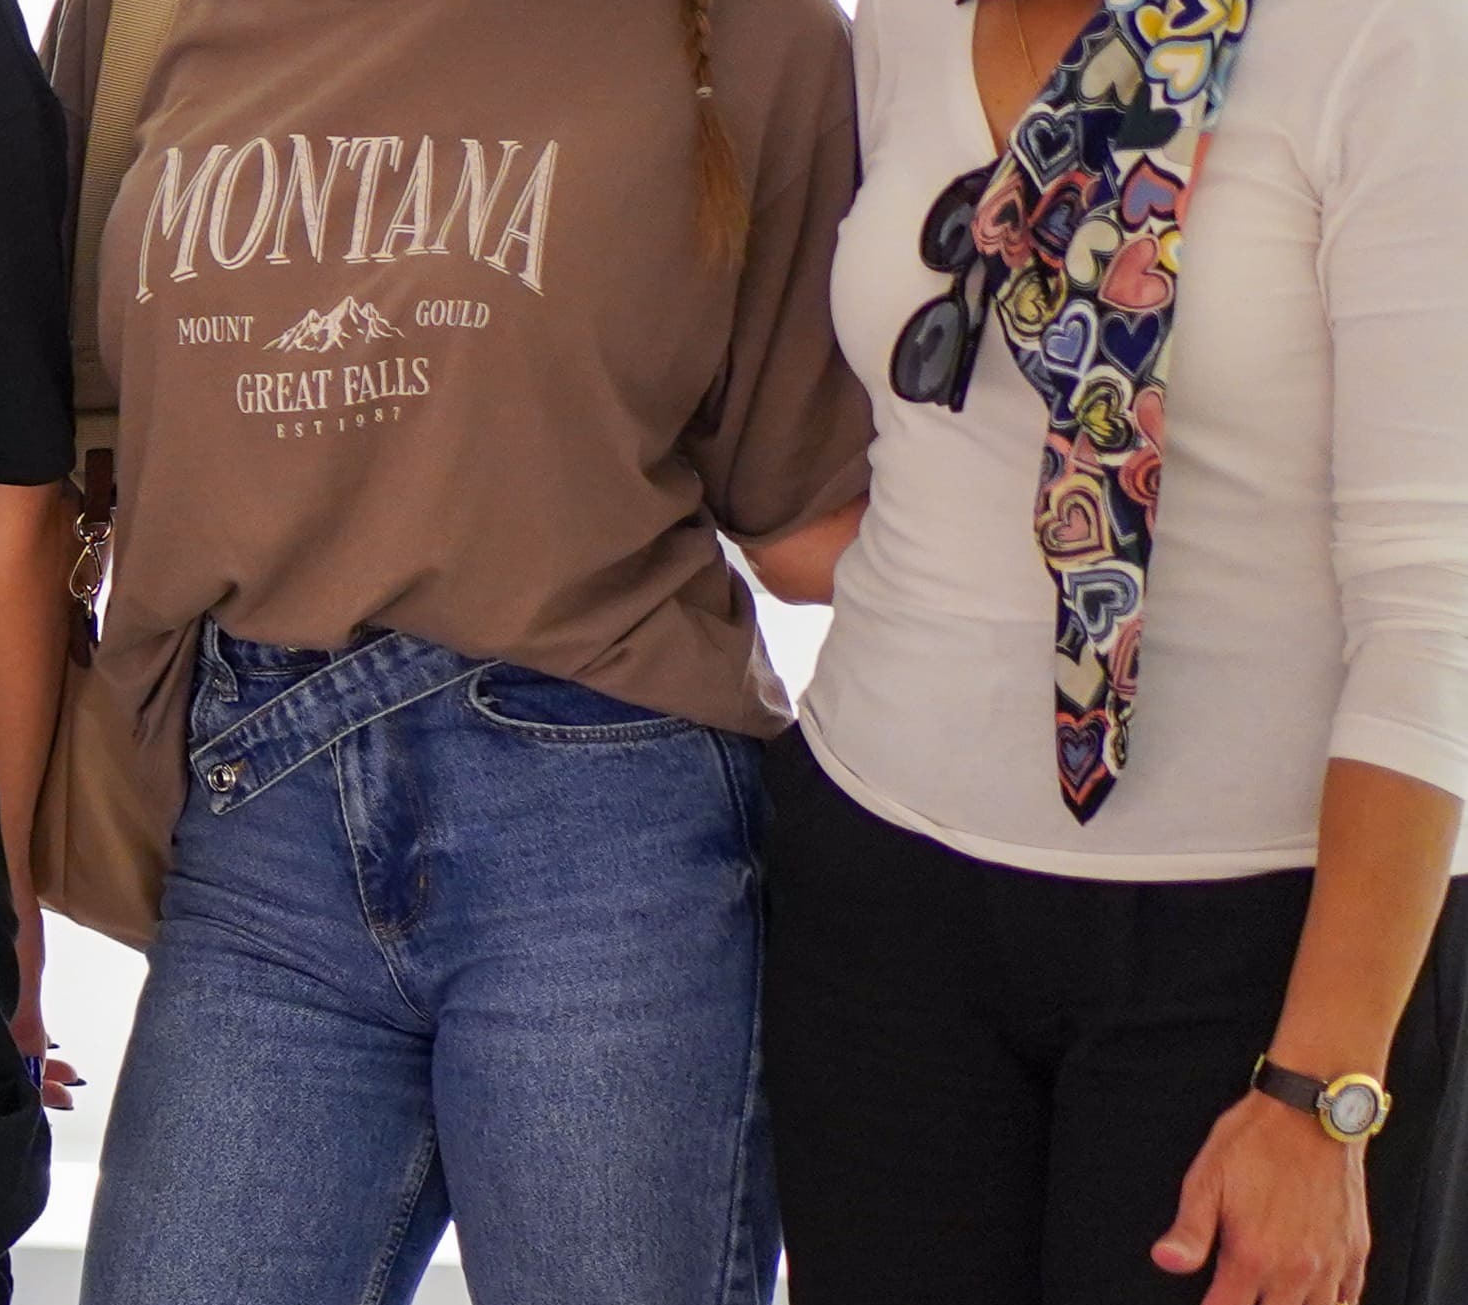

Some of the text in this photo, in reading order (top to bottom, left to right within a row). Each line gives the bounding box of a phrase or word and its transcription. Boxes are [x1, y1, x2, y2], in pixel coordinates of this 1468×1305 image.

[136, 134, 559, 303] MONTANA
[177, 299, 491, 346] MOUNT GOULD
[236, 357, 431, 414] GREAT FALLS
[276, 420, 323, 439] EST
